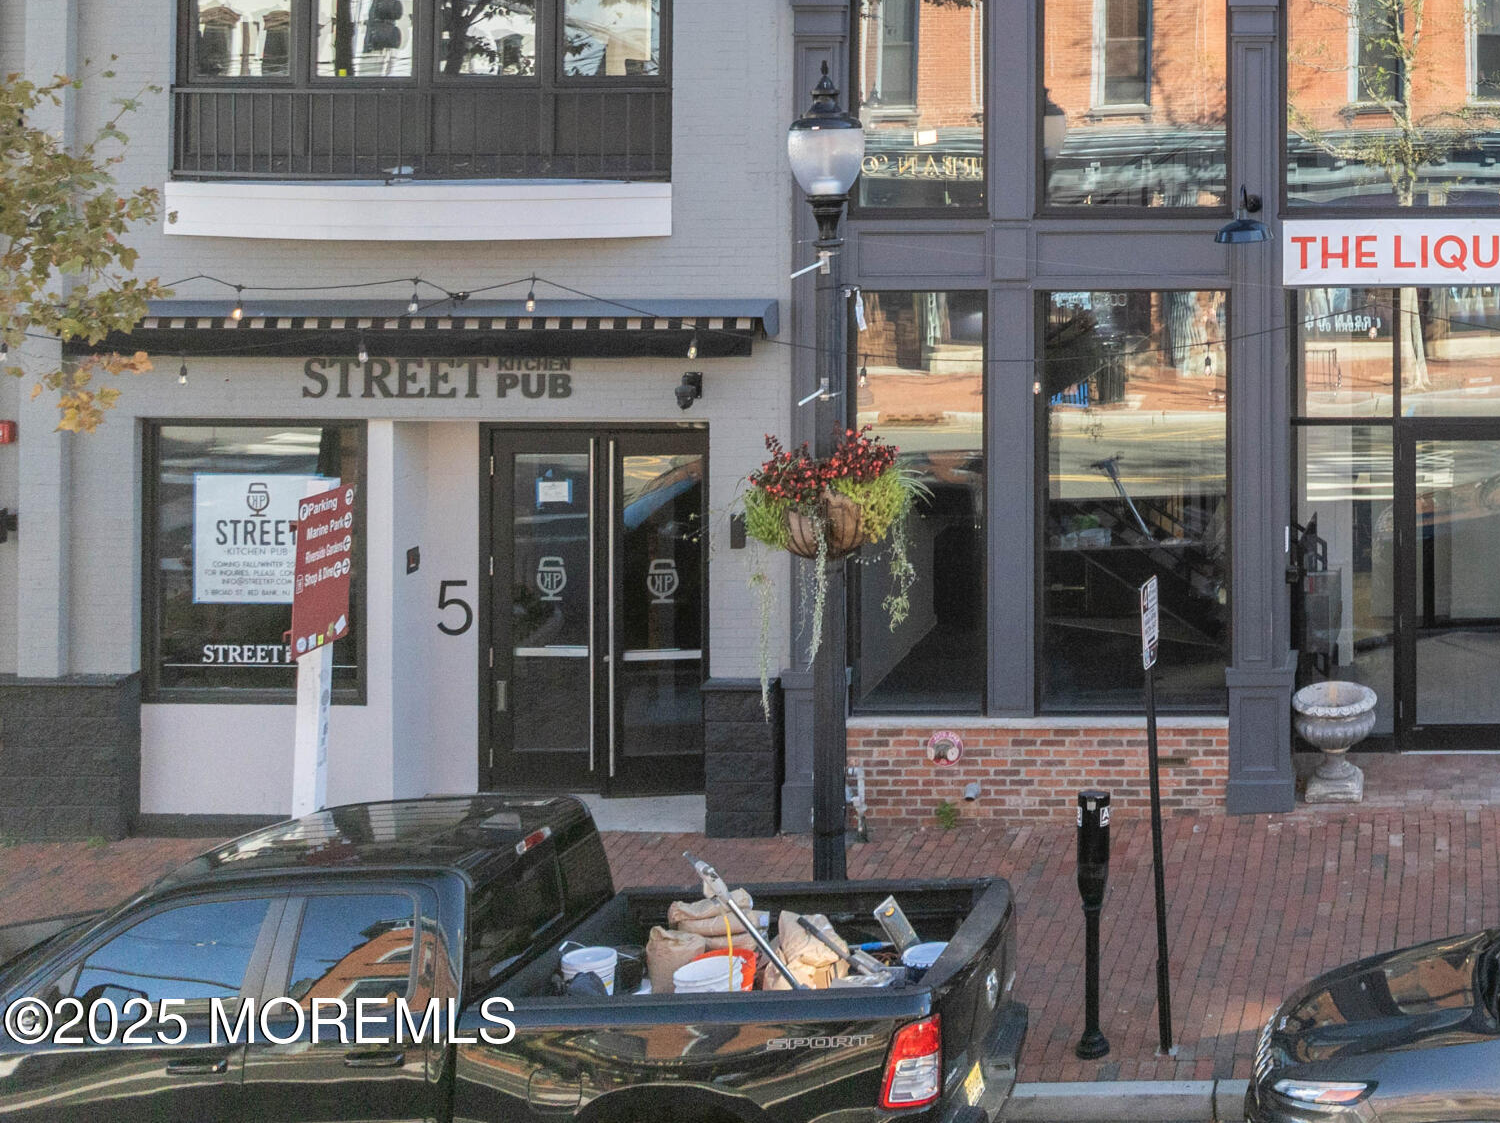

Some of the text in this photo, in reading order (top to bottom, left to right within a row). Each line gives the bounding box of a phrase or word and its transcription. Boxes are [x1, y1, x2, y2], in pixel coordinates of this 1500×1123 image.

[1290, 235, 1378, 269] THE
[497, 357, 571, 372] KITCHEN
[302, 357, 489, 399] STREET
[496, 373, 572, 399] PUB
[308, 497, 338, 516] Parking
[306, 516, 345, 541] Marine Park
[437, 579, 473, 636] 5
[202, 644, 283, 664] STREET
[767, 1034, 874, 1050] SPORT
